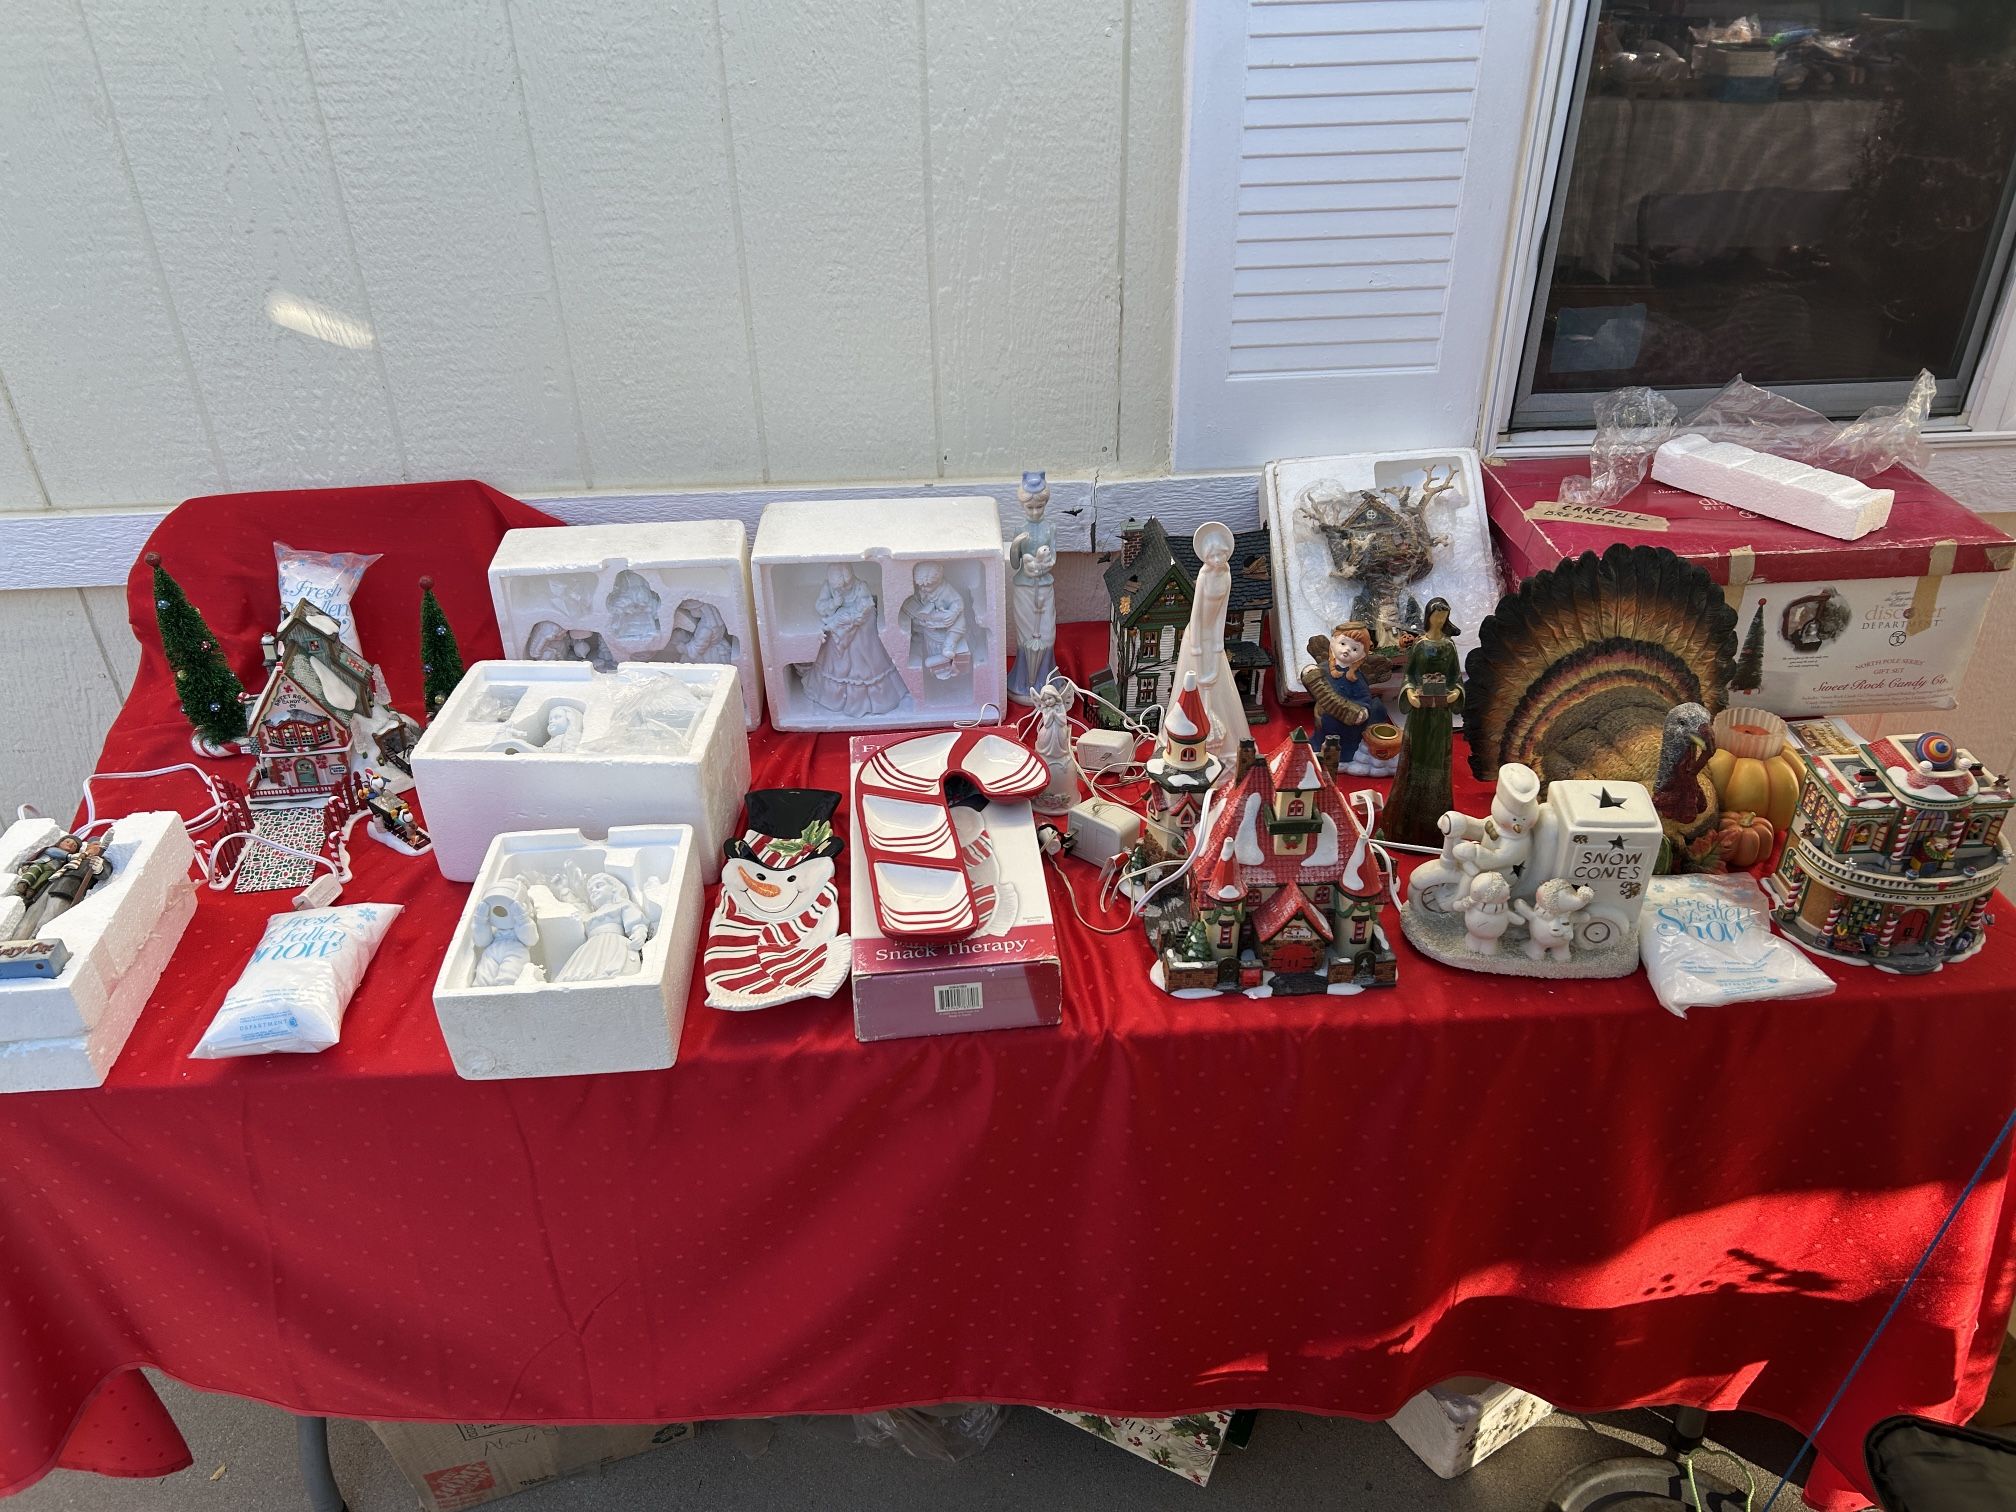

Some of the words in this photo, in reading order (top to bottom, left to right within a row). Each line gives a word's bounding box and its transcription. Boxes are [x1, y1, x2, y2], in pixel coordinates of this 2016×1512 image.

[1562, 505, 1648, 521] CAREFUL
[1813, 681, 1850, 692] Sweet
[1850, 679, 1887, 690] Rock
[1888, 676, 1928, 690] Candy
[1581, 851, 1643, 866] SNOW
[1574, 866, 1642, 879] CONES
[1873, 892, 1908, 900] ELFIN
[875, 945, 938, 961] Snack
[943, 937, 1029, 957] Therapy
